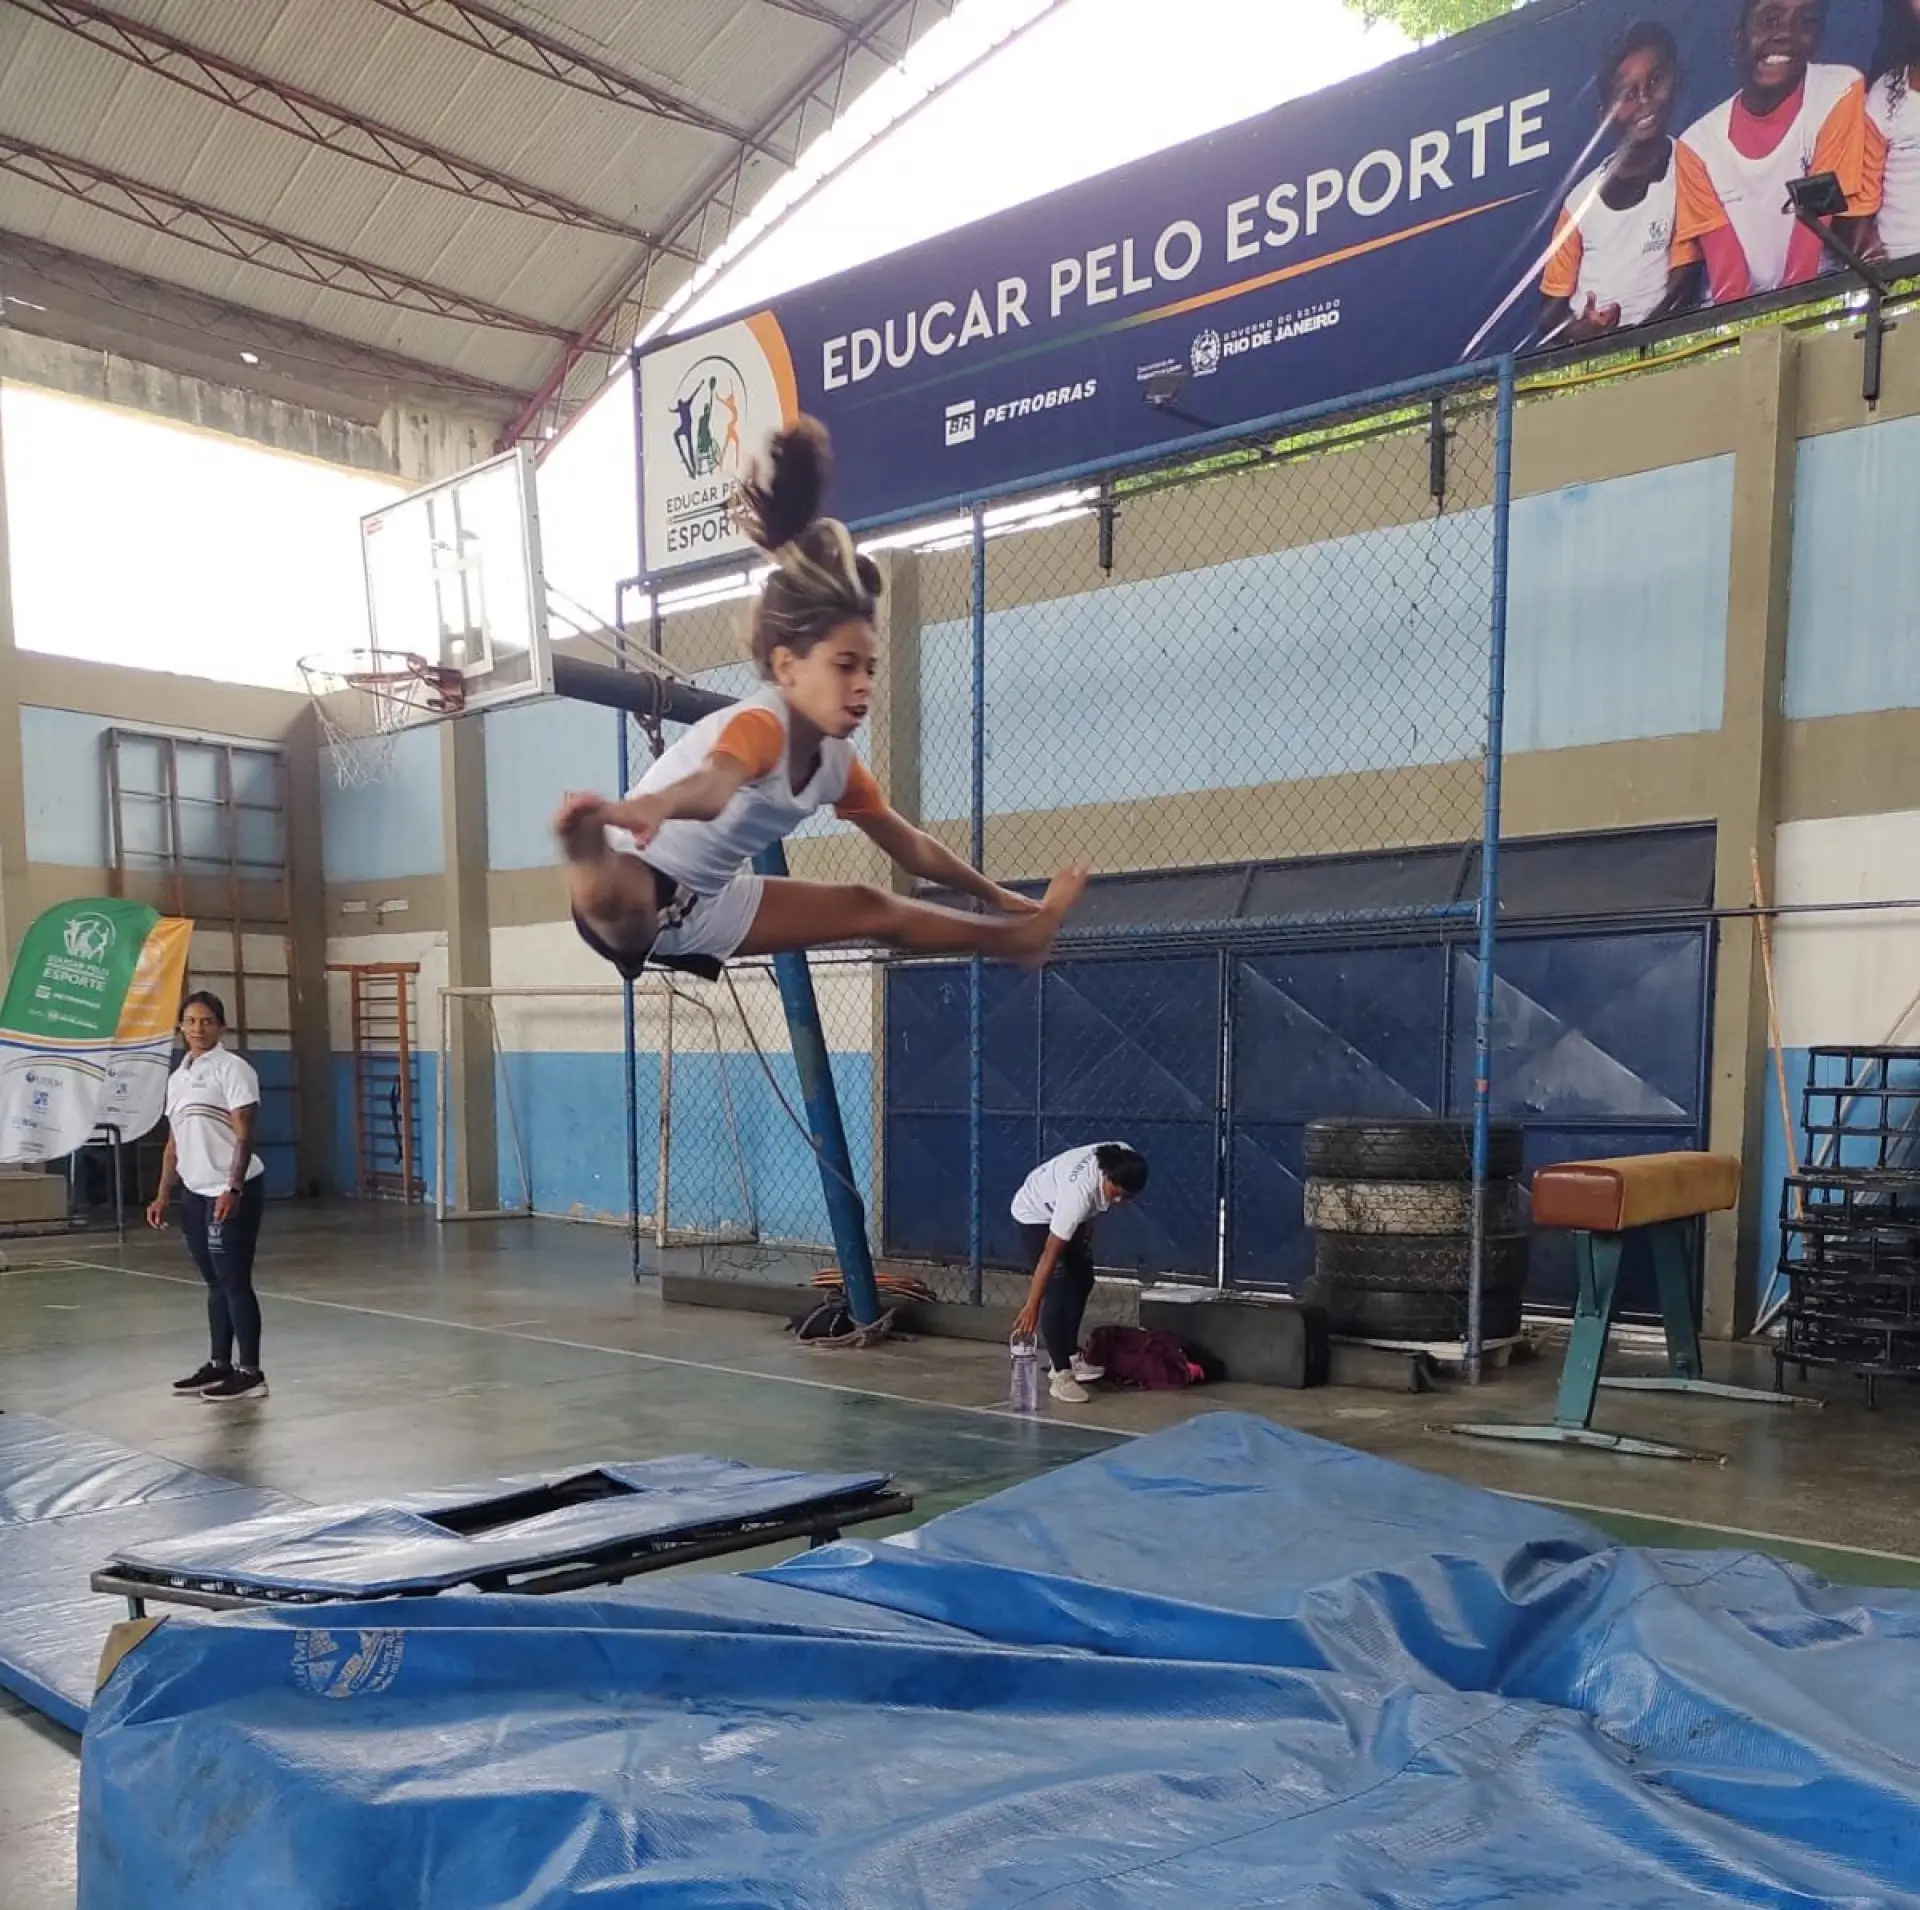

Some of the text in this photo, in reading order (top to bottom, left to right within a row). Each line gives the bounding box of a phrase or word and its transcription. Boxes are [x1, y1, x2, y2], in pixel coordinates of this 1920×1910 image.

[822, 88, 1551, 392] EDUCAR PELO ESPORTE
[1223, 309, 1340, 358] RIO DE JANEIRO
[948, 378, 1098, 436] BR PETROBRAS
[666, 485, 718, 514] EDUCAR
[667, 515, 742, 553] ESPORT
